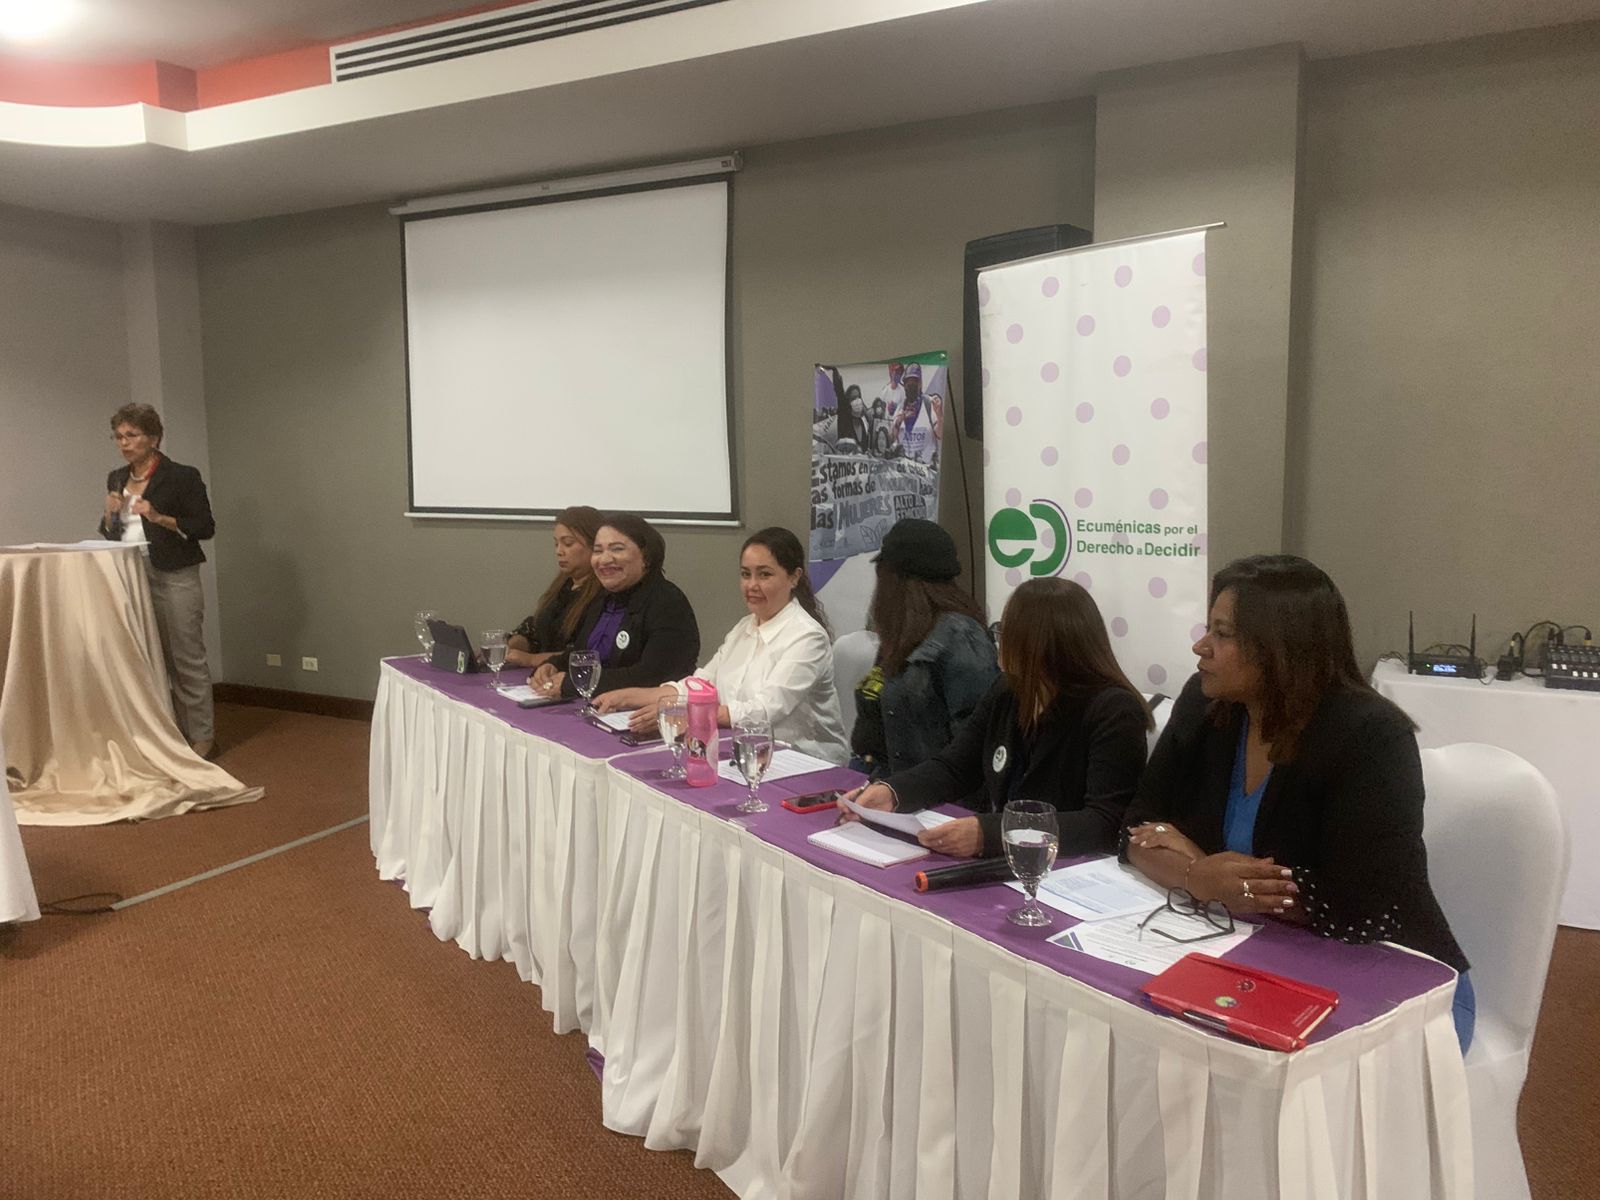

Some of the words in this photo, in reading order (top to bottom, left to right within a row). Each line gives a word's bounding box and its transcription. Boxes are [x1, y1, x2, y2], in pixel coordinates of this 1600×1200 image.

[811, 458, 856, 487] Estamos
[859, 462, 869, 474] en
[832, 480, 863, 499] formas
[865, 475, 876, 493] de
[810, 504, 834, 530] las
[1077, 519, 1161, 534] Ecuménicas
[1164, 525, 1183, 536] por
[1187, 524, 1198, 534] el
[1076, 540, 1134, 555] Derecho
[1136, 548, 1143, 556] a
[1144, 542, 1201, 557] Decidir
